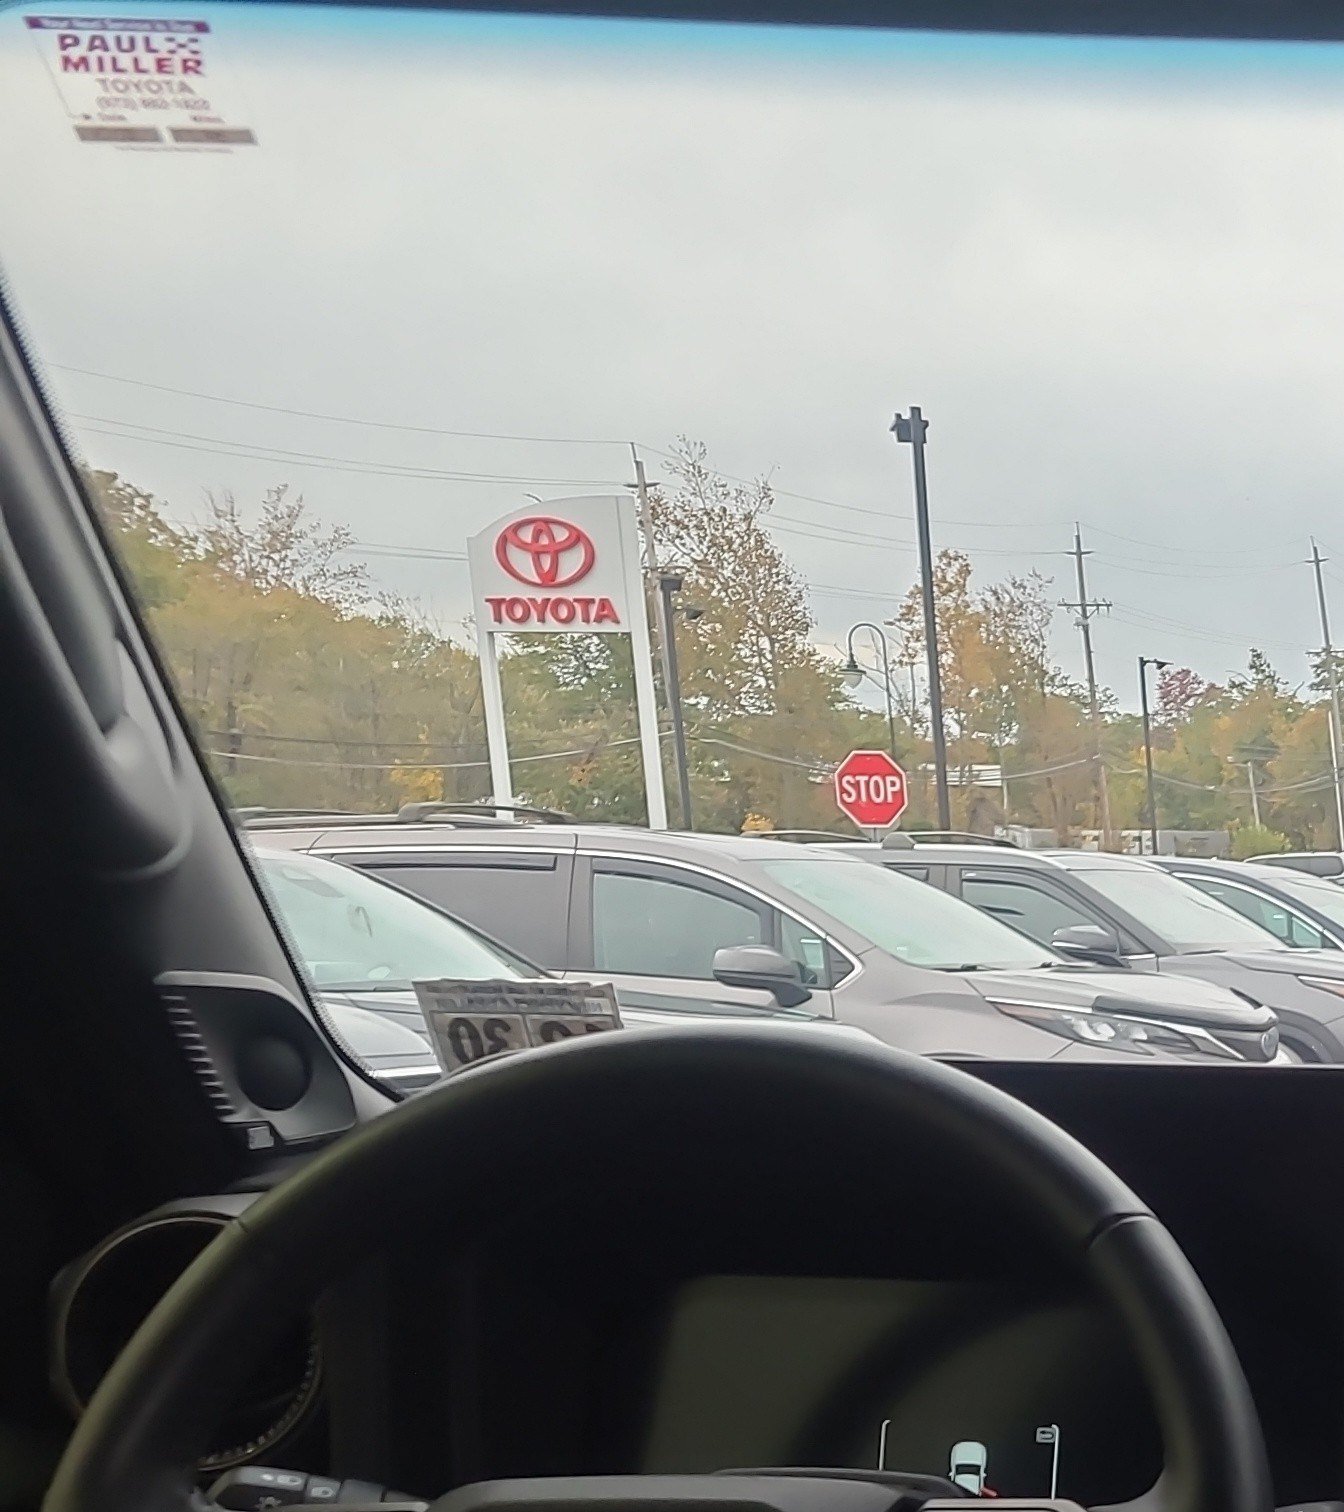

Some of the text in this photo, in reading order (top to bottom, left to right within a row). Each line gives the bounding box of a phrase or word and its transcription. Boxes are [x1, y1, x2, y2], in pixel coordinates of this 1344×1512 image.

[57, 33, 159, 54] PAUL
[60, 55, 205, 75] MILLER
[95, 78, 196, 95] TOYOTA
[484, 596, 621, 625] TOYOTA
[841, 774, 901, 804] STOP
